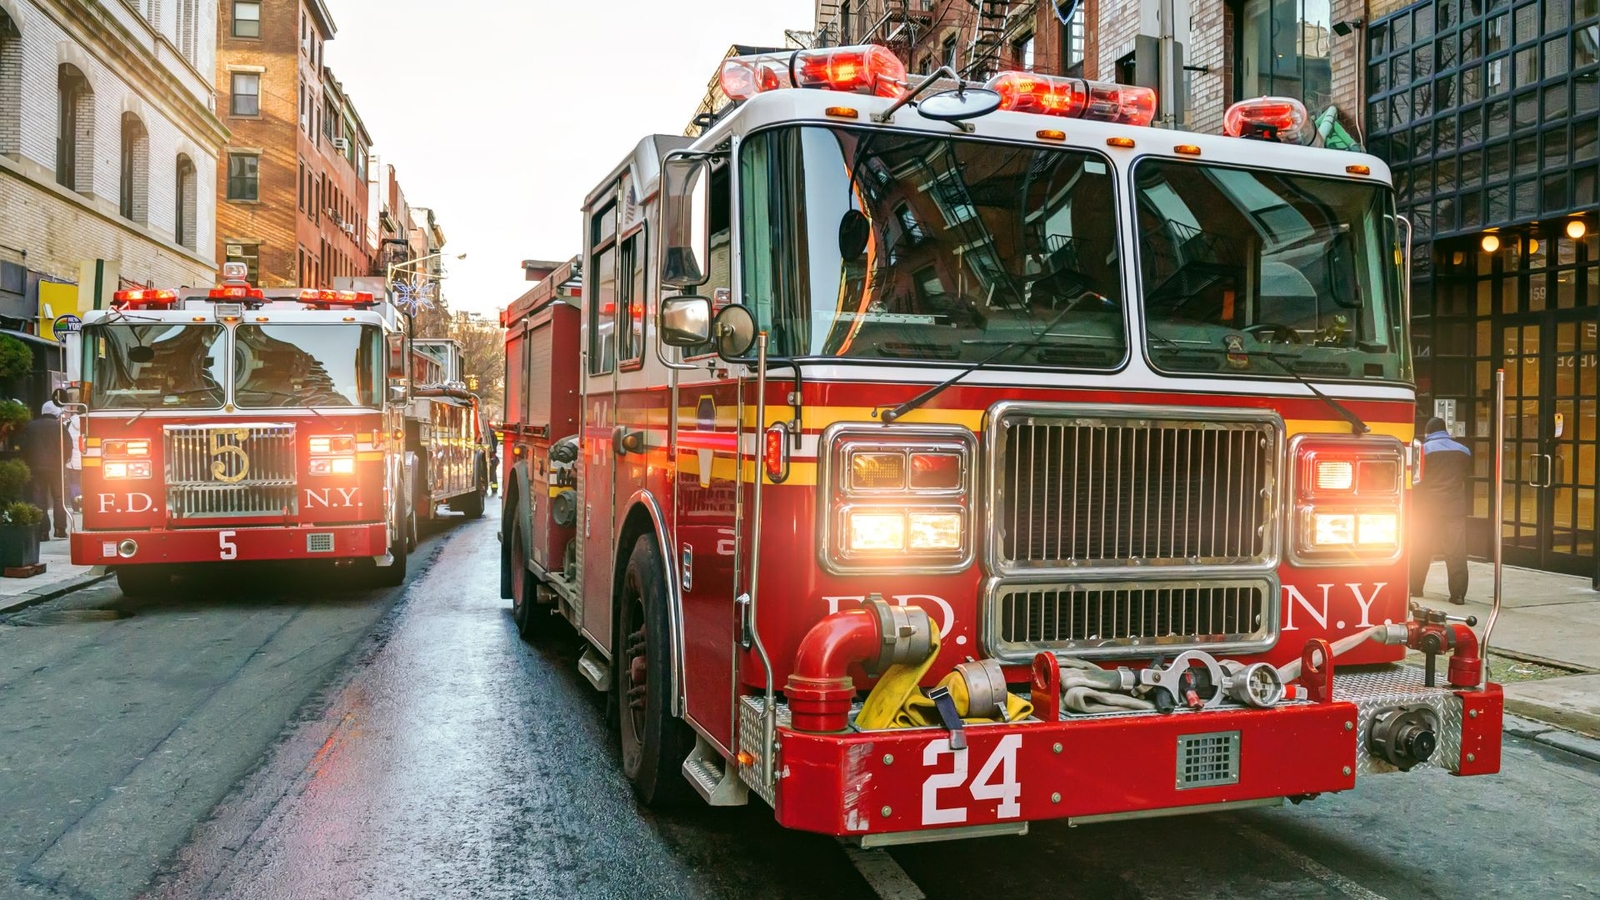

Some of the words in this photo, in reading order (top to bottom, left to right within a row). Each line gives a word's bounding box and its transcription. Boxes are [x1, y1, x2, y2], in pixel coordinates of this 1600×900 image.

[1530, 287, 1546, 300] 159
[68, 323, 81, 331] YOR
[209, 427, 249, 484] 5
[97, 492, 158, 513] F.D.
[303, 487, 363, 508] N.Y.
[219, 530, 238, 560] 5
[1281, 582, 1393, 631] N.Y.
[922, 733, 1022, 826] 24
